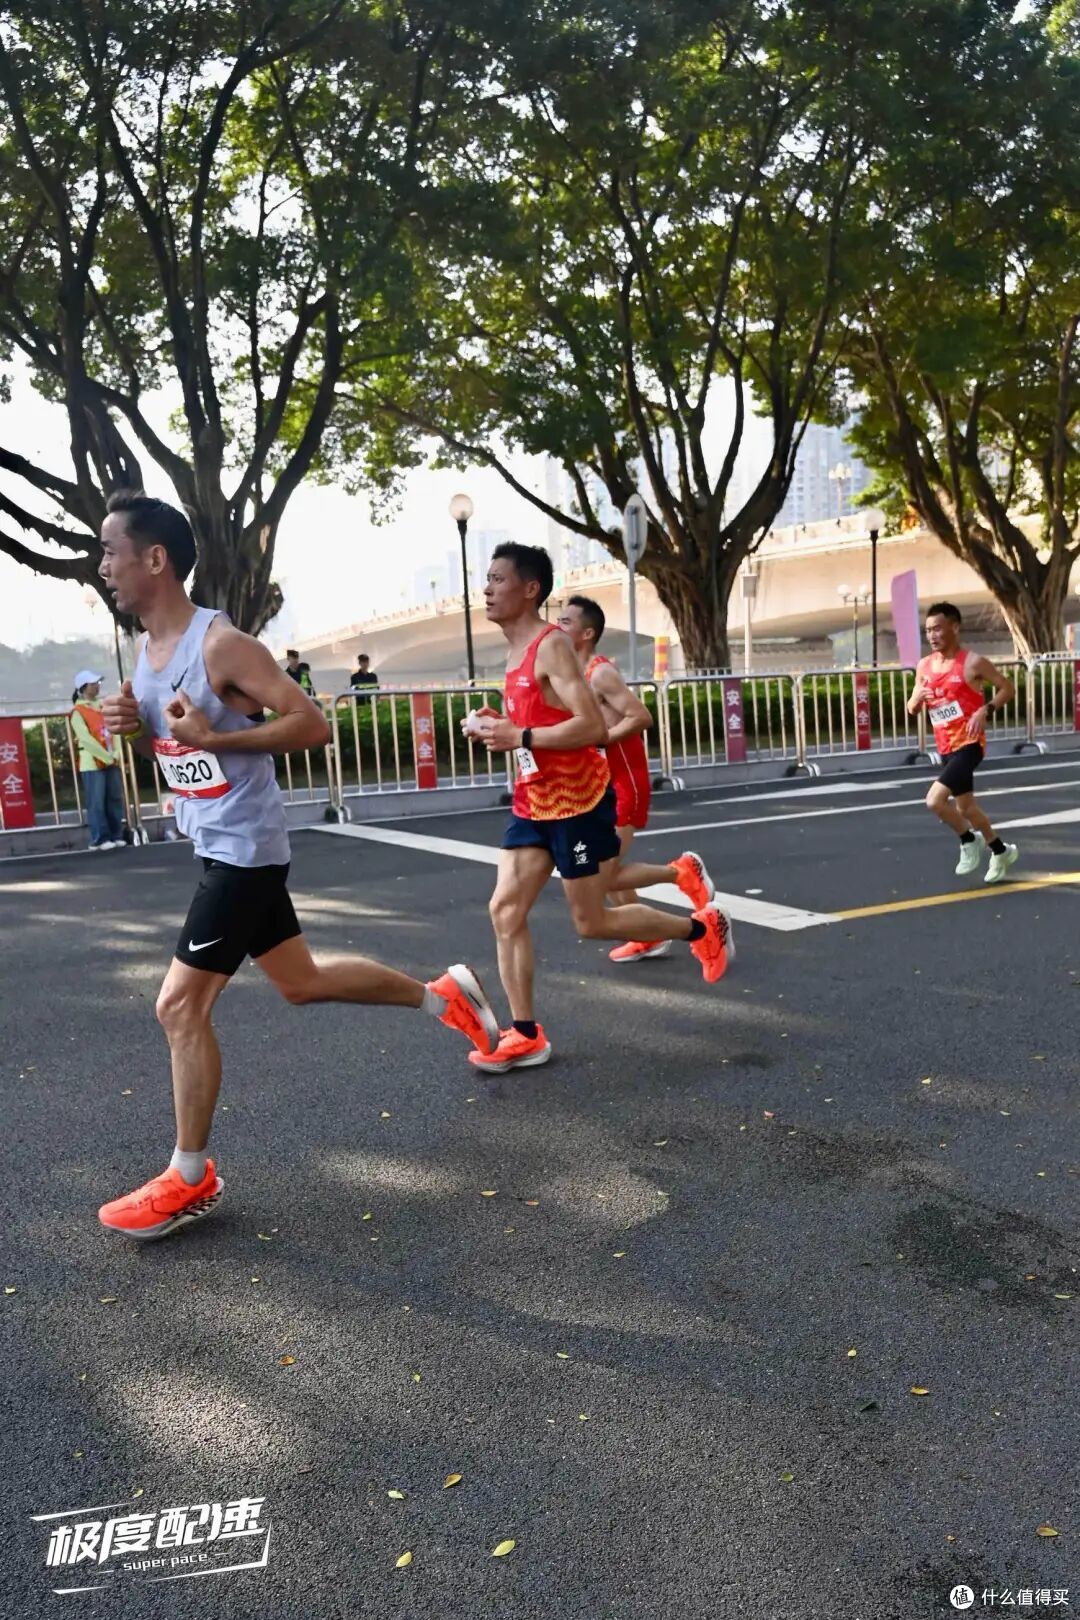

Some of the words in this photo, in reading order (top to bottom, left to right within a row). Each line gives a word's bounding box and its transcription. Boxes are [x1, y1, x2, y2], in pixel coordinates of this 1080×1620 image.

[726, 690, 742, 730] 安全
[857, 687, 870, 725] 安全
[417, 717, 433, 758] 安全
[0, 743, 24, 795] 安全
[169, 759, 212, 784] 0620
